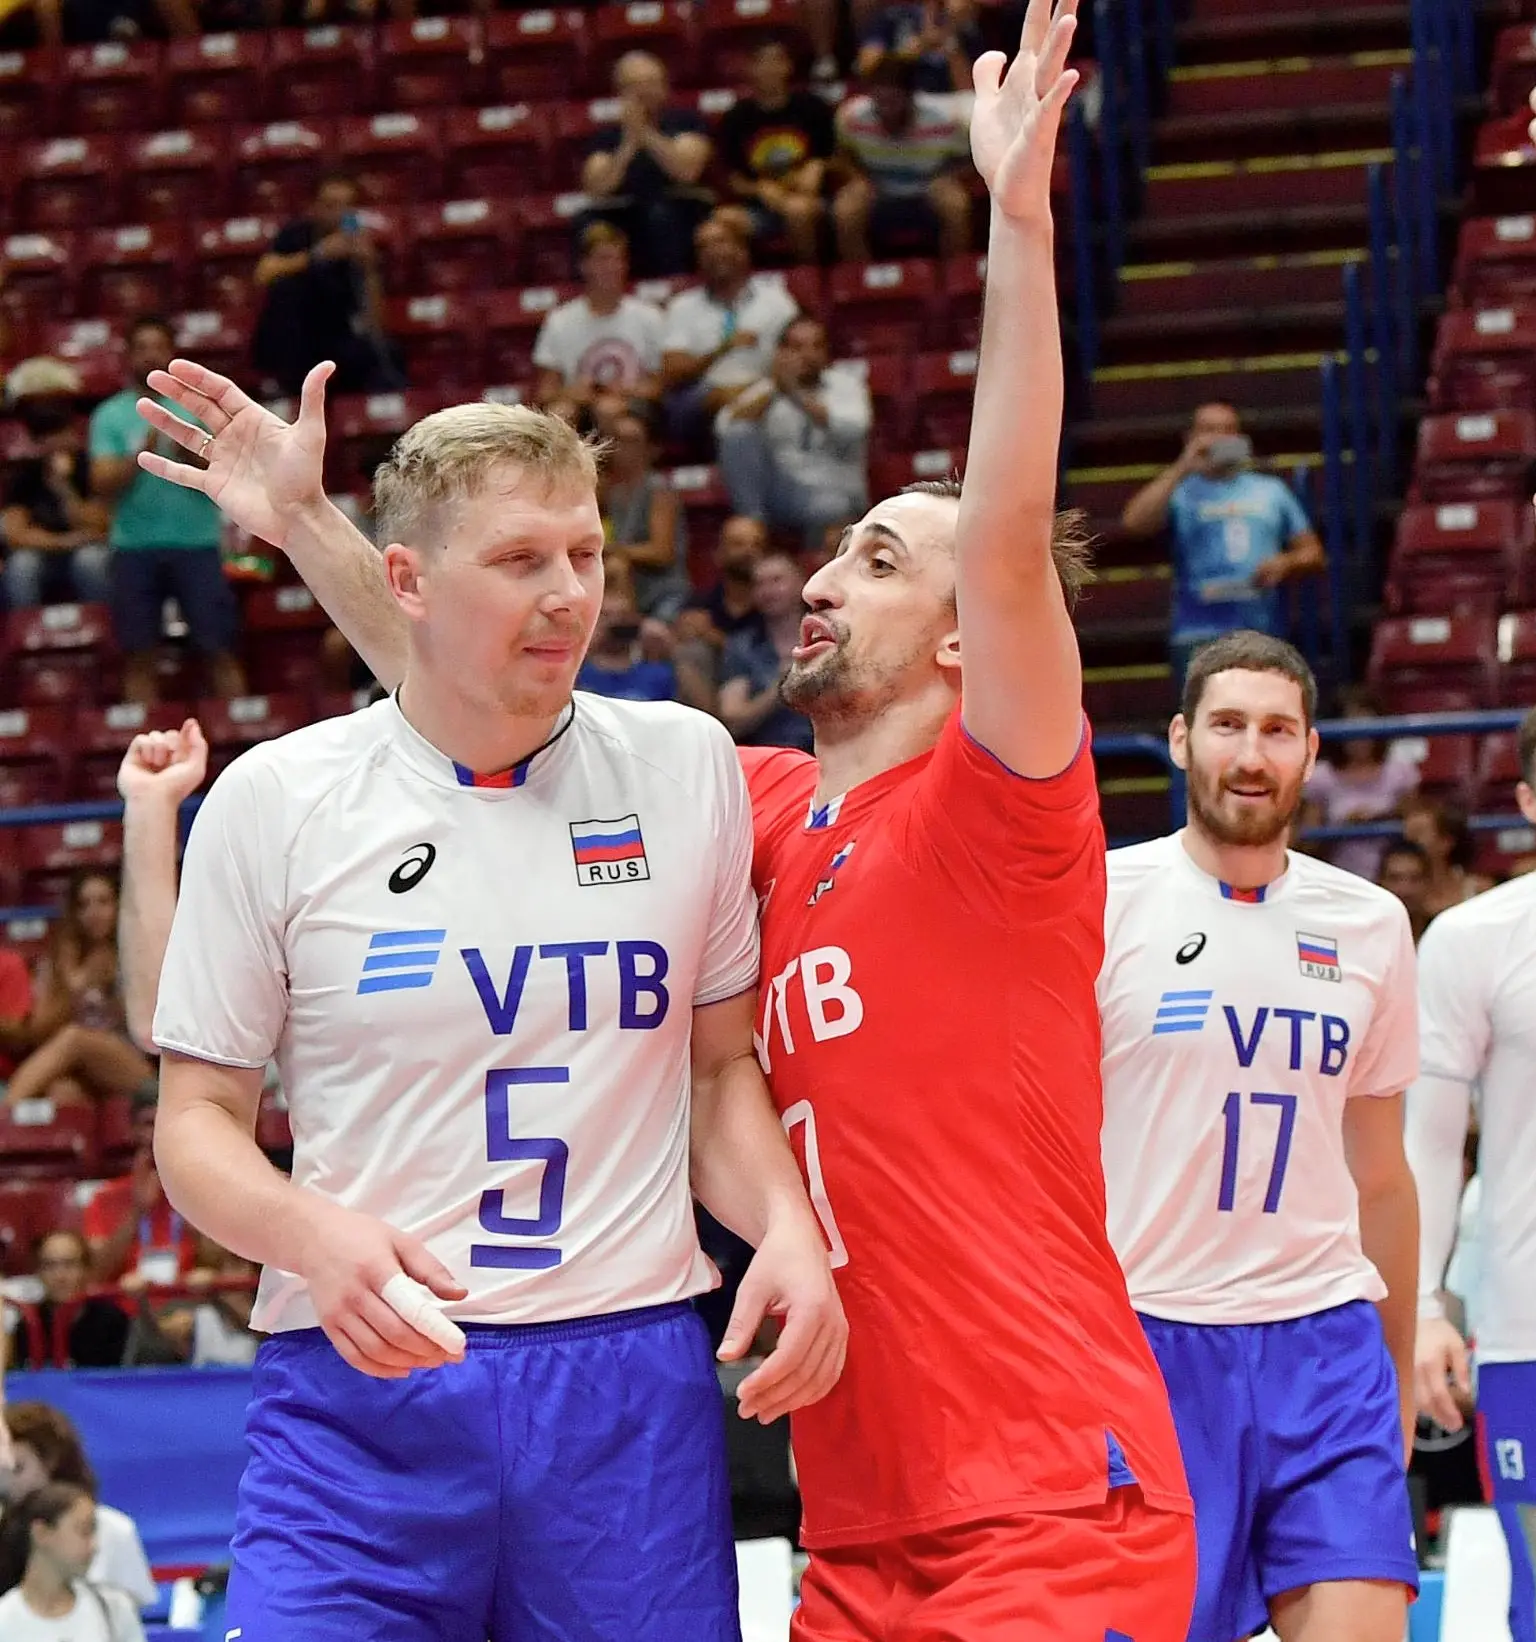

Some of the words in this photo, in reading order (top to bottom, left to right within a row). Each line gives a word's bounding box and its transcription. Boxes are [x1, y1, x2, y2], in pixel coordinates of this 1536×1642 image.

[590, 862, 639, 881] RUS
[460, 941, 670, 1035] VTB
[1222, 1005, 1350, 1076] VTB
[479, 1067, 570, 1236] 5
[1217, 1092, 1297, 1213] 17
